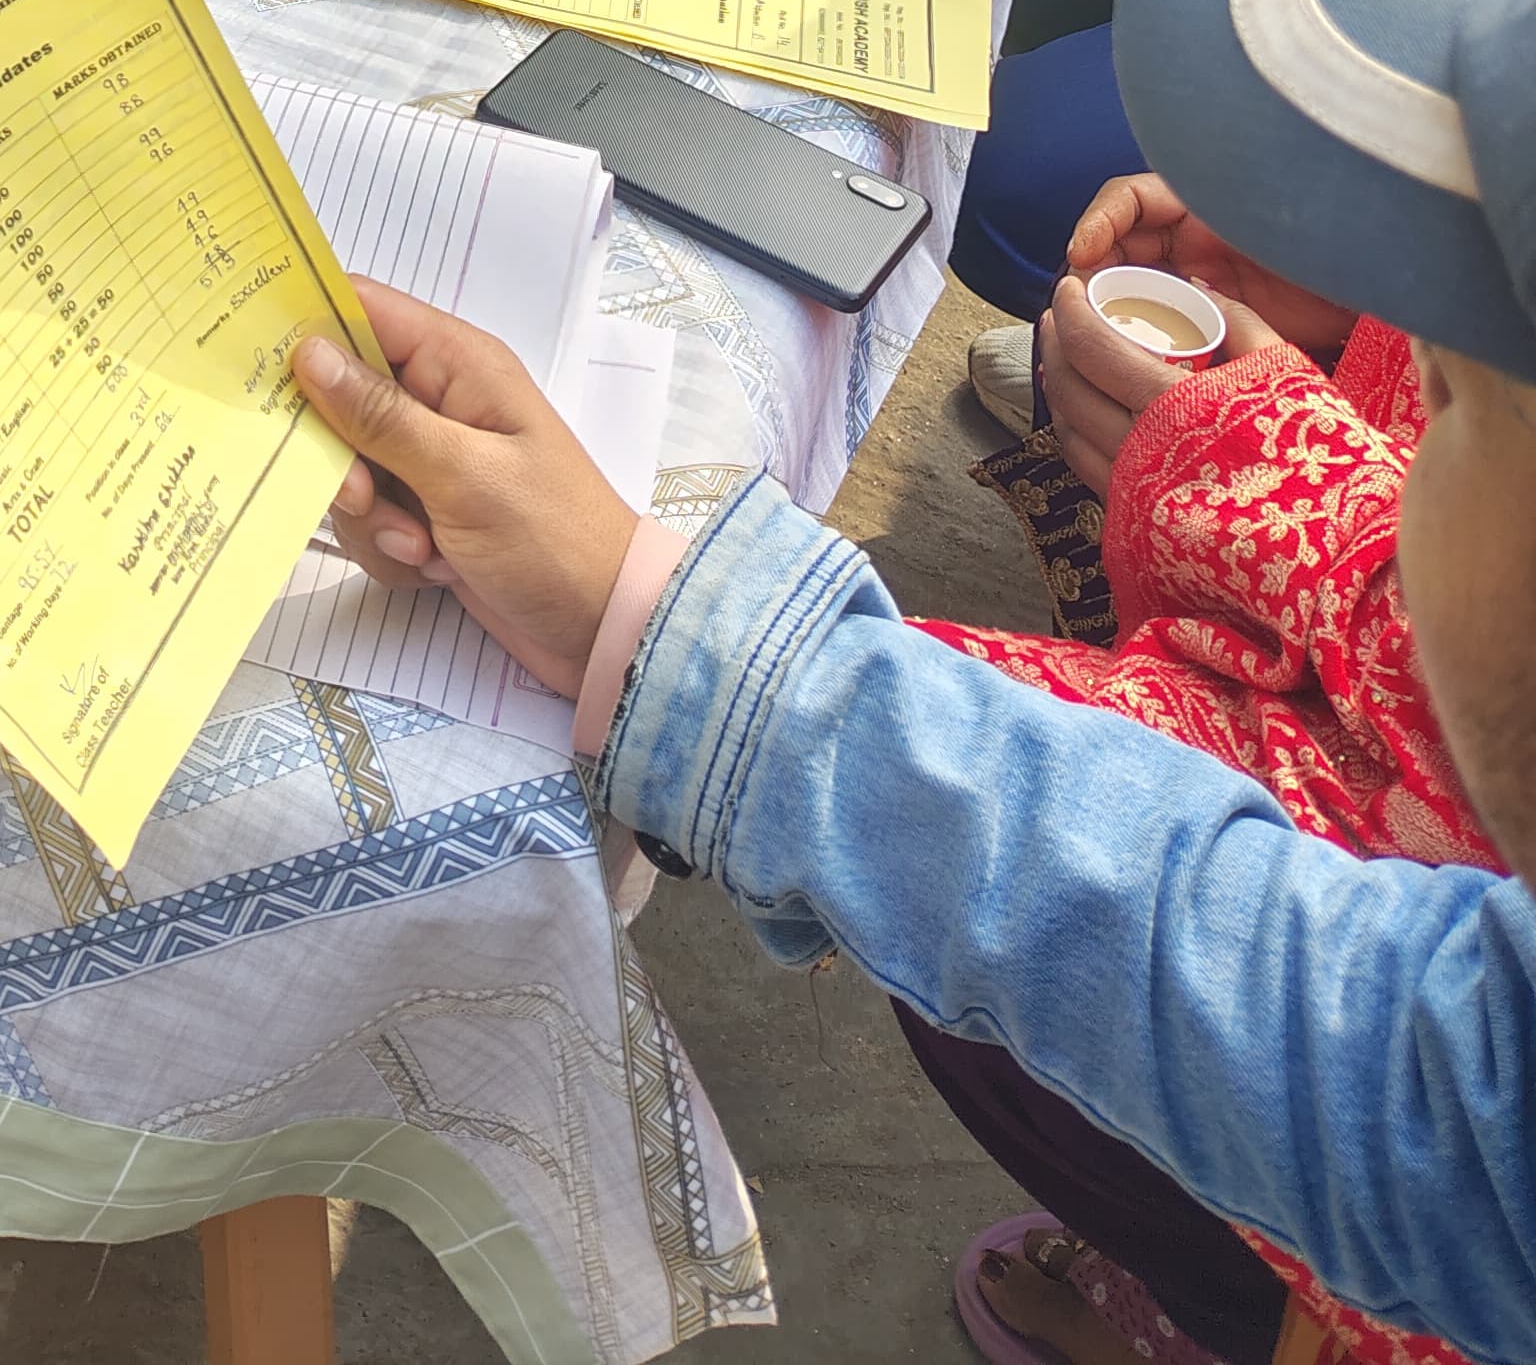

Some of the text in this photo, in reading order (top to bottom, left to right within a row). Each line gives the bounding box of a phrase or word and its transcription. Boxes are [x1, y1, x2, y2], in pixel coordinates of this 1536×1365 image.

[51, 62, 99, 102] MARKS
[97, 18, 163, 70] OBTAINED
[851, 17, 869, 74] ACADEMY
[7, 224, 36, 257] 100
[18, 241, 46, 274] 100
[33, 260, 55, 287] 50
[45, 278, 66, 305] 50
[47, 343, 67, 369] 25
[70, 313, 91, 339] 25
[95, 285, 115, 311] 50
[58, 296, 78, 323] 50
[82, 333, 101, 359] 50
[94, 351, 114, 376] 50
[6, 478, 55, 547] TOTAL
[18, 605, 50, 648] Working
[42, 582, 64, 610] Days
[59, 663, 110, 747] Signature of
[92, 674, 134, 737] Teacher
